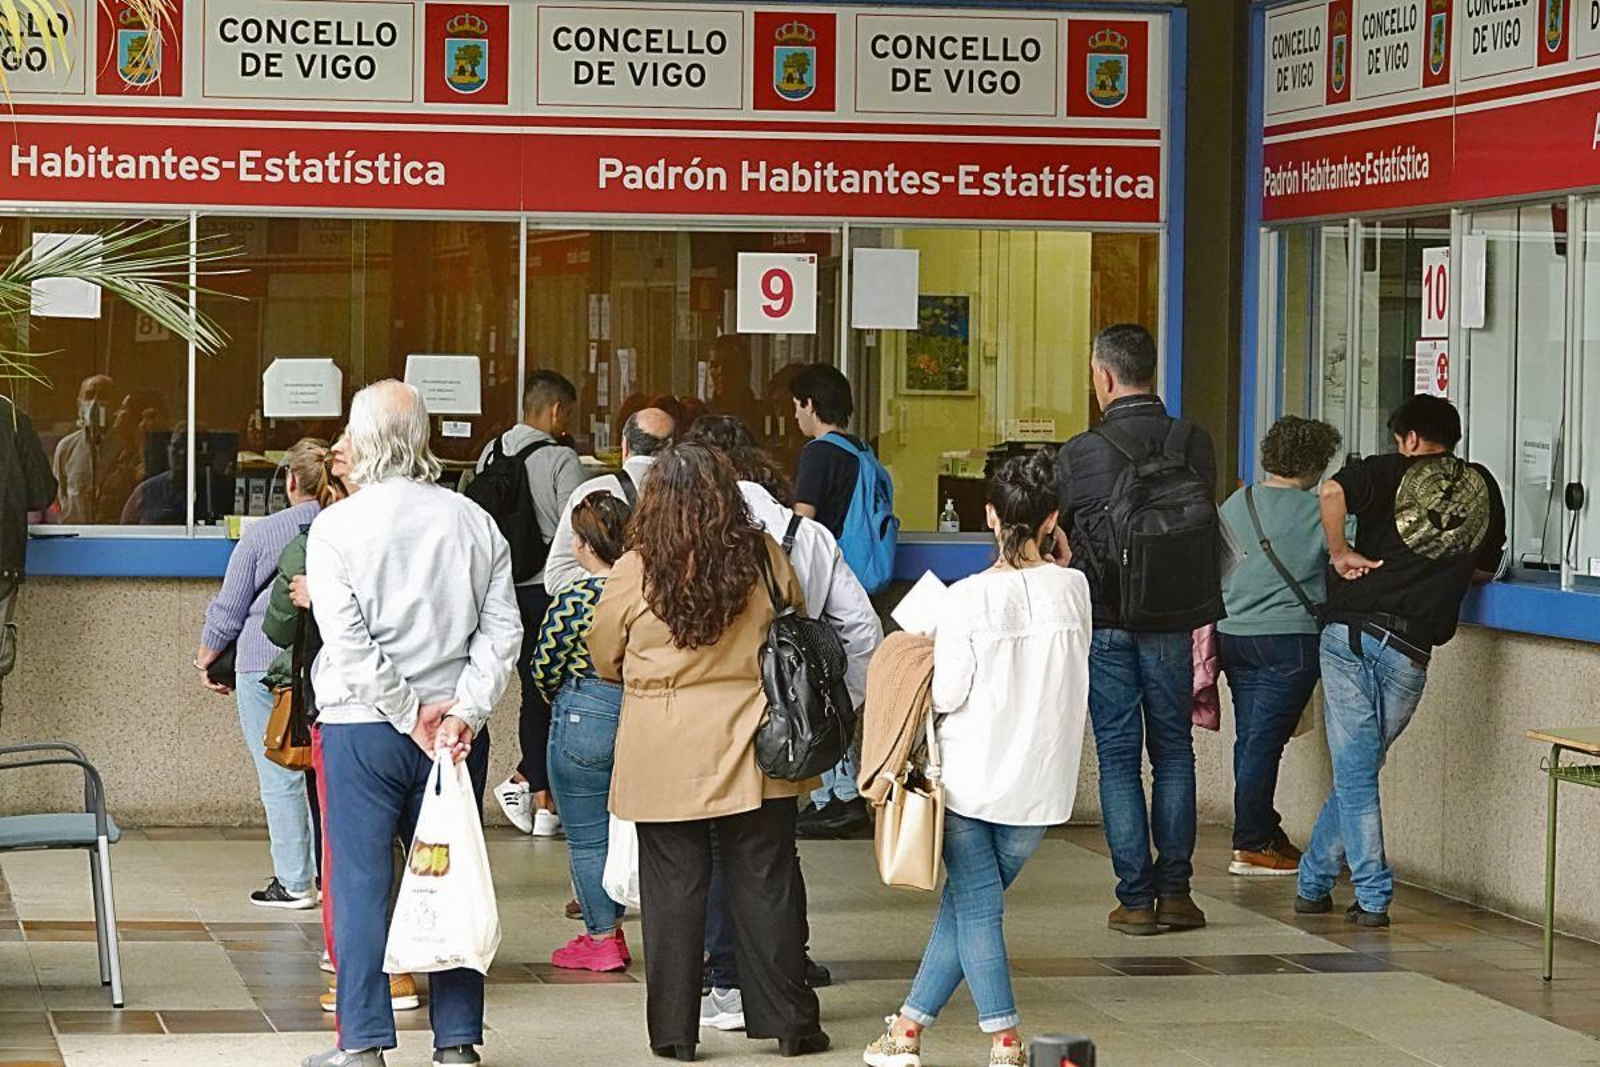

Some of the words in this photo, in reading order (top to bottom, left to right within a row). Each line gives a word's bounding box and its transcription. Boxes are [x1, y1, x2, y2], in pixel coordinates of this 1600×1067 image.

[219, 17, 397, 47] CONCELLO
[1362, 4, 1417, 41] CONCELLO
[1472, 24, 1489, 55] DE
[1491, 17, 1521, 51] VIGO
[552, 26, 727, 55] CONCELLO
[870, 34, 1041, 63] CONCELLO
[1271, 25, 1321, 60] CONCELLO
[240, 52, 283, 78] DE
[295, 53, 376, 81] VIGO
[574, 60, 616, 86] DE
[627, 61, 706, 88] VIGO
[1367, 47, 1381, 75] DE
[1383, 41, 1409, 72] VIGO
[891, 67, 932, 93] DE
[944, 68, 1021, 95] VIGO
[1276, 65, 1290, 93] DE
[1291, 60, 1314, 90] VIGO
[11, 145, 446, 186] Habitantes-Estatística
[598, 157, 727, 191] Padrón
[741, 160, 1154, 199] Habitantes-Estatística
[1263, 161, 1299, 197] Padrón
[1301, 146, 1429, 192] Habitantes-Estatística
[761, 268, 794, 318] 9
[1424, 264, 1447, 320] 10
